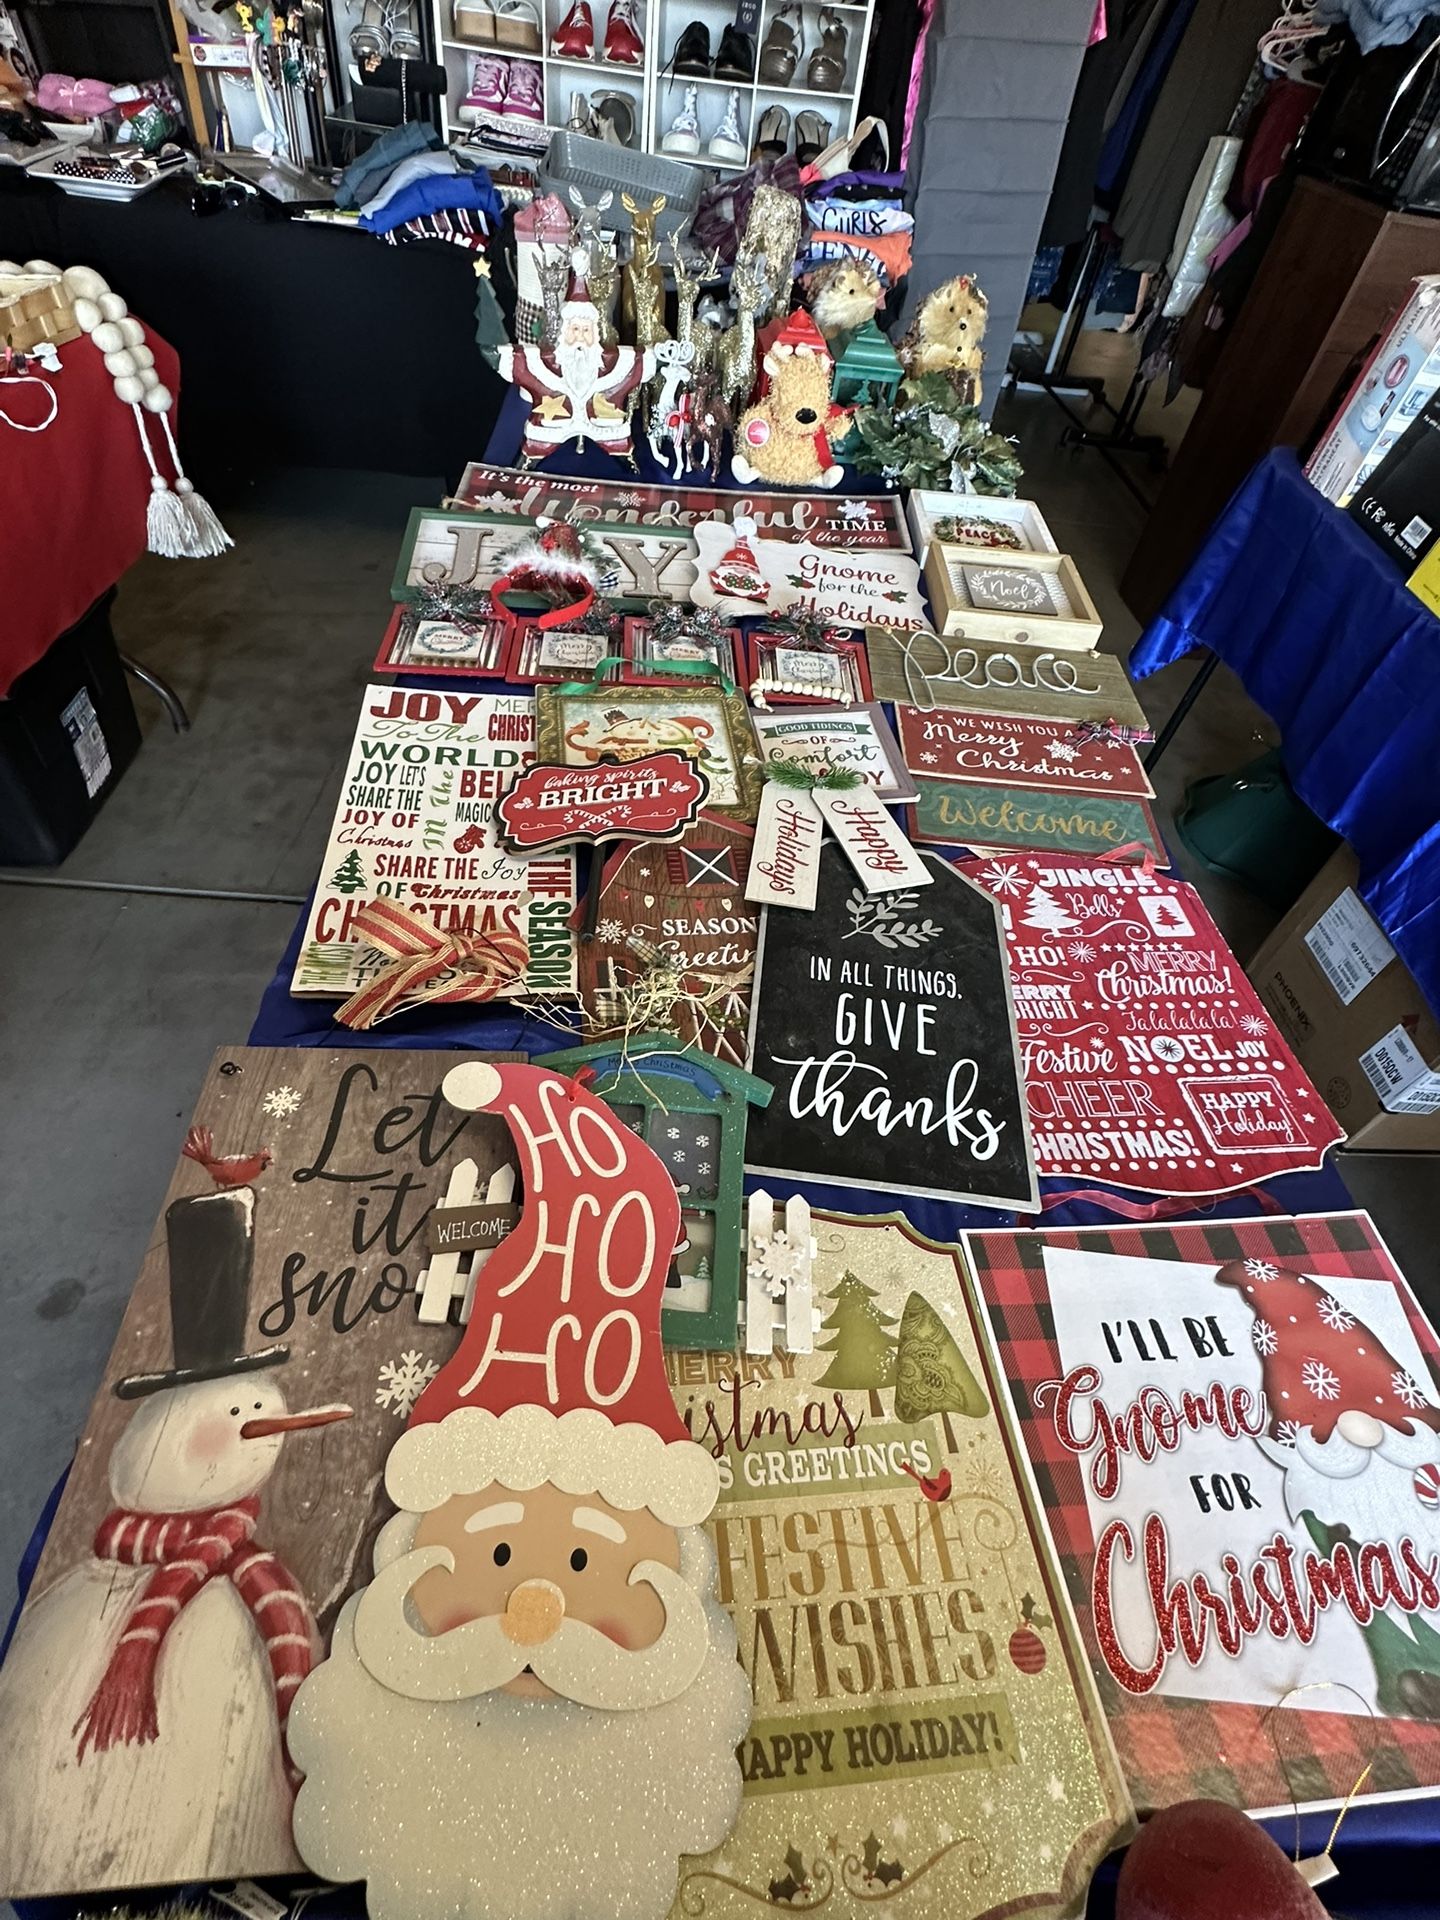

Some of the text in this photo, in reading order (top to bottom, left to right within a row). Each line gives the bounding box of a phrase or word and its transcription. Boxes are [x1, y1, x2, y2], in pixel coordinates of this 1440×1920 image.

[479, 469, 600, 493] It's the most
[816, 532, 840, 543] the
[843, 536, 887, 547] year
[826, 519, 887, 532] TIME
[955, 528, 997, 540] PEACE
[422, 526, 688, 600] JY
[799, 554, 898, 585] Gnome
[819, 578, 881, 598] for the
[990, 580, 1029, 599] Noel
[787, 595, 923, 632] Holidays
[370, 691, 537, 724] JOY MER
[363, 719, 486, 743] To The
[488, 713, 536, 742] CHRIST
[778, 721, 853, 734] GOOD TIDINGS
[811, 736, 828, 744] OF
[923, 721, 1024, 757] Merry
[953, 716, 1074, 738] WE WISH YOU A
[360, 740, 519, 767] WORLD
[769, 744, 880, 767] Comfort
[956, 748, 1114, 782] Christmas
[352, 761, 427, 786] JOY LET'S
[460, 770, 519, 799] BEL
[544, 767, 658, 790] baking spirits
[346, 785, 423, 811] SHARE THE
[537, 778, 669, 811] BRIGHT
[341, 809, 420, 828] JOY OF
[455, 802, 492, 823] MAGIC
[940, 794, 1128, 842] Welcome
[337, 826, 413, 848] Christmas
[756, 799, 817, 895] Holidays
[831, 800, 909, 875] Happy
[373, 854, 527, 881] SHARE THE Joy
[1036, 868, 1157, 888] JINGLE
[376, 881, 521, 901] OF Christmas
[1065, 893, 1121, 918] Bells
[315, 897, 521, 944] CHTMAS
[526, 857, 572, 988] THE SEASON
[658, 939, 757, 969] Greeti
[1014, 946, 1068, 966] HO!
[1127, 950, 1217, 972] MERRY
[810, 955, 832, 981] IN
[840, 960, 873, 987] ALL
[1094, 960, 1235, 1004] Christmas!
[1011, 984, 1071, 999] ERRY
[1274, 971, 1311, 1029] PHOENIX
[834, 992, 938, 1056] GIVE
[1019, 1038, 1118, 1079] Festive
[1117, 1033, 1270, 1063] NOEL JOY
[643, 1056, 697, 1077] Christmas
[771, 1050, 1006, 1161] thanks
[1025, 1080, 1165, 1118] CHEER
[1199, 1091, 1275, 1109] HAPPY
[293, 1063, 470, 1183] Let
[509, 1080, 627, 1192] HO
[352, 1172, 437, 1257] it
[437, 1217, 512, 1244] WELCOME
[497, 1190, 654, 1303] HO
[259, 1252, 440, 1337] sno
[1101, 1315, 1235, 1364] I'LL BE
[458, 1308, 642, 1405] HO
[684, 1371, 864, 1460] istmas
[1034, 1364, 1268, 1501] Gnome
[743, 1438, 934, 1488] GREETINGS
[1189, 1471, 1262, 1514] FOR
[711, 1500, 972, 1604] FESTIVE
[1093, 1512, 1440, 1696] Christmas
[730, 1587, 998, 1706] WISHES
[843, 1710, 1004, 1770] HOLIDAY!
